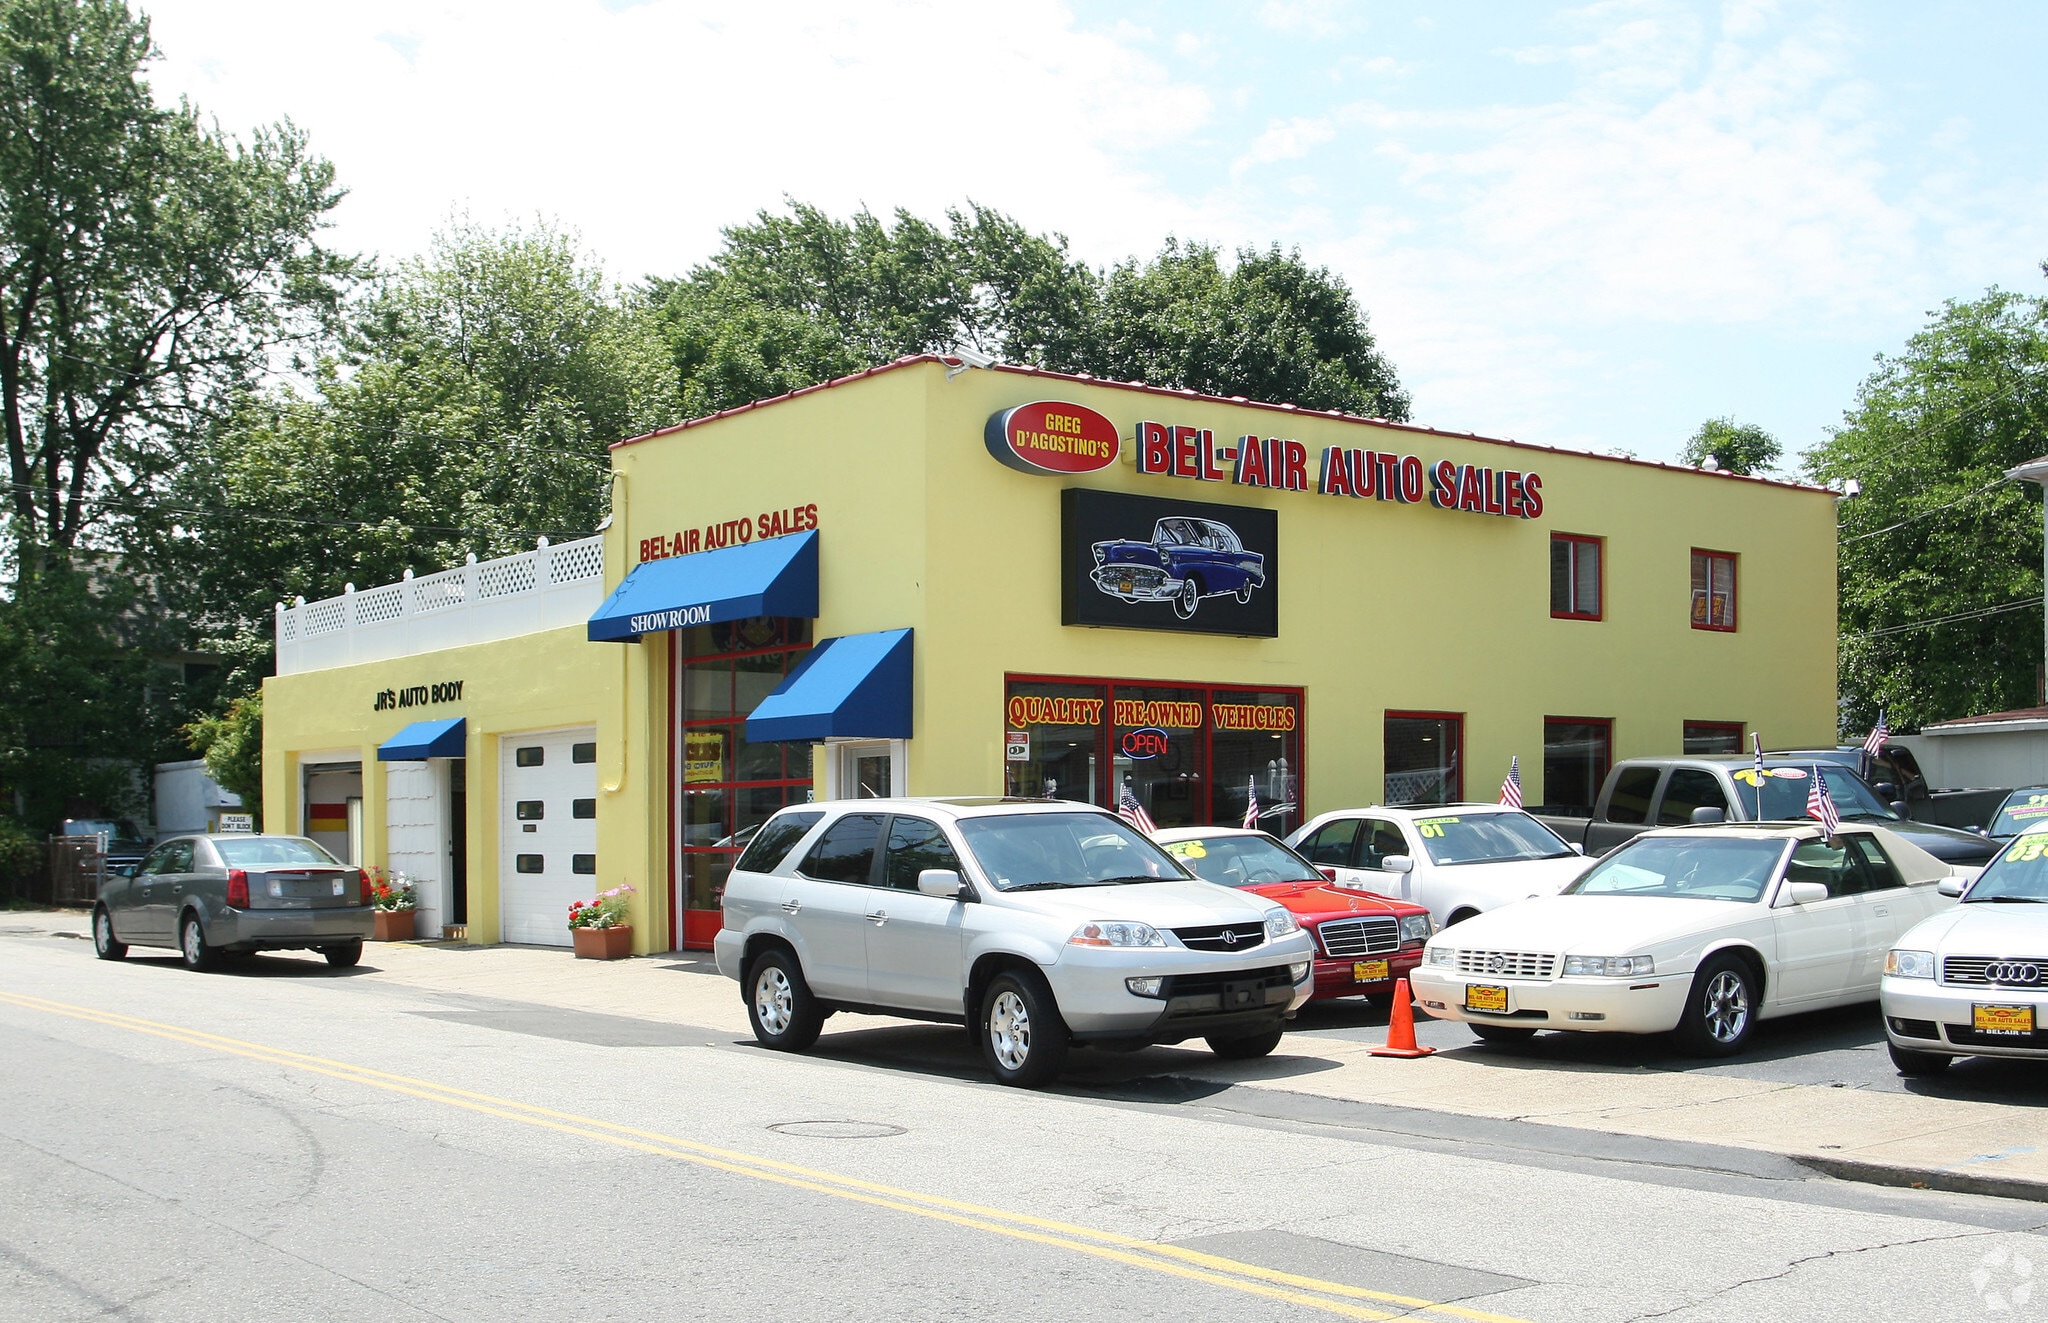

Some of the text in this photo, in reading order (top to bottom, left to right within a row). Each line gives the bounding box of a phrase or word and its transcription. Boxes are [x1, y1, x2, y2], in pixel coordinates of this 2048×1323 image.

[1046, 413, 1081, 434] GREG
[1016, 429, 1109, 458] D'AGOSTINO'S
[1140, 420, 1544, 519] BEL-AIR AUTO SALES
[639, 503, 818, 562] BEL-AIR AUTO SALES
[630, 605, 711, 633] SHOWROOM
[374, 680, 464, 711] JR'S AUTO BODY
[1009, 696, 1295, 731] QUALITY PRE-OWNED VEHICLES
[1122, 733, 1167, 754] OPEN
[1420, 824, 1445, 838] 01
